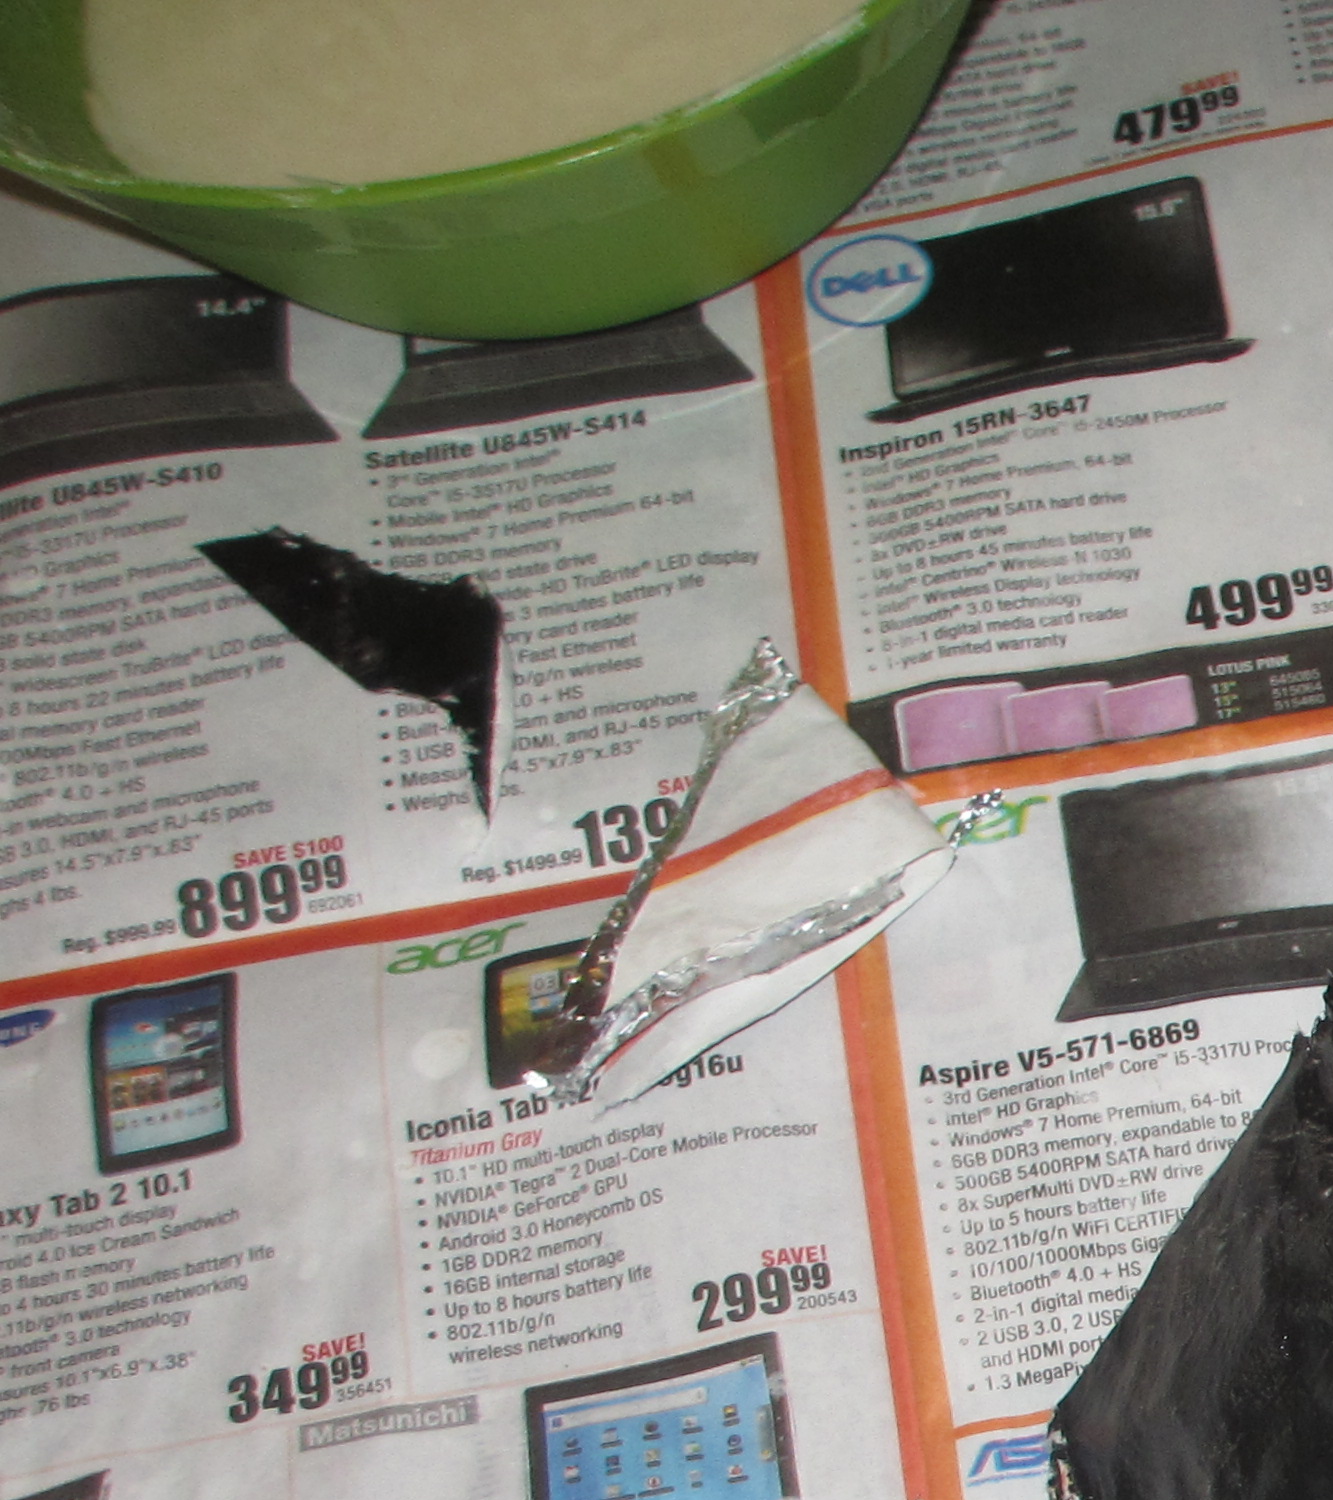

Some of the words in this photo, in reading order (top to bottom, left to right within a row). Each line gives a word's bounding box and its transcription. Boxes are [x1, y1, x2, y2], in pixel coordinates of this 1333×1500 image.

[820, 258, 923, 298] DELL
[364, 443, 473, 470] Satellite
[483, 410, 645, 454] U845W-S414
[839, 430, 943, 463] Inspiron
[953, 395, 1089, 437] 15RN-3647
[233, 841, 288, 869] SAVE
[293, 835, 343, 862] $100
[386, 923, 527, 973] acer
[920, 1060, 1009, 1088] Aspire
[1018, 1019, 1199, 1072] V5-571-6869
[406, 1103, 494, 1141] Iconia
[499, 1094, 547, 1121] Tab
[410, 1132, 495, 1167] Titanium
[498, 1126, 542, 1155] Gray
[50, 1182, 103, 1217] Tab
[109, 1179, 127, 1202] 2
[134, 1170, 192, 1201] 10.1
[444, 1276, 490, 1295] 16GB
[496, 1263, 560, 1288] internal
[565, 1250, 624, 1275] storage
[761, 1244, 828, 1272] SAVE!
[301, 1333, 366, 1362] SAVE!
[306, 1401, 469, 1446] Matsunichi
